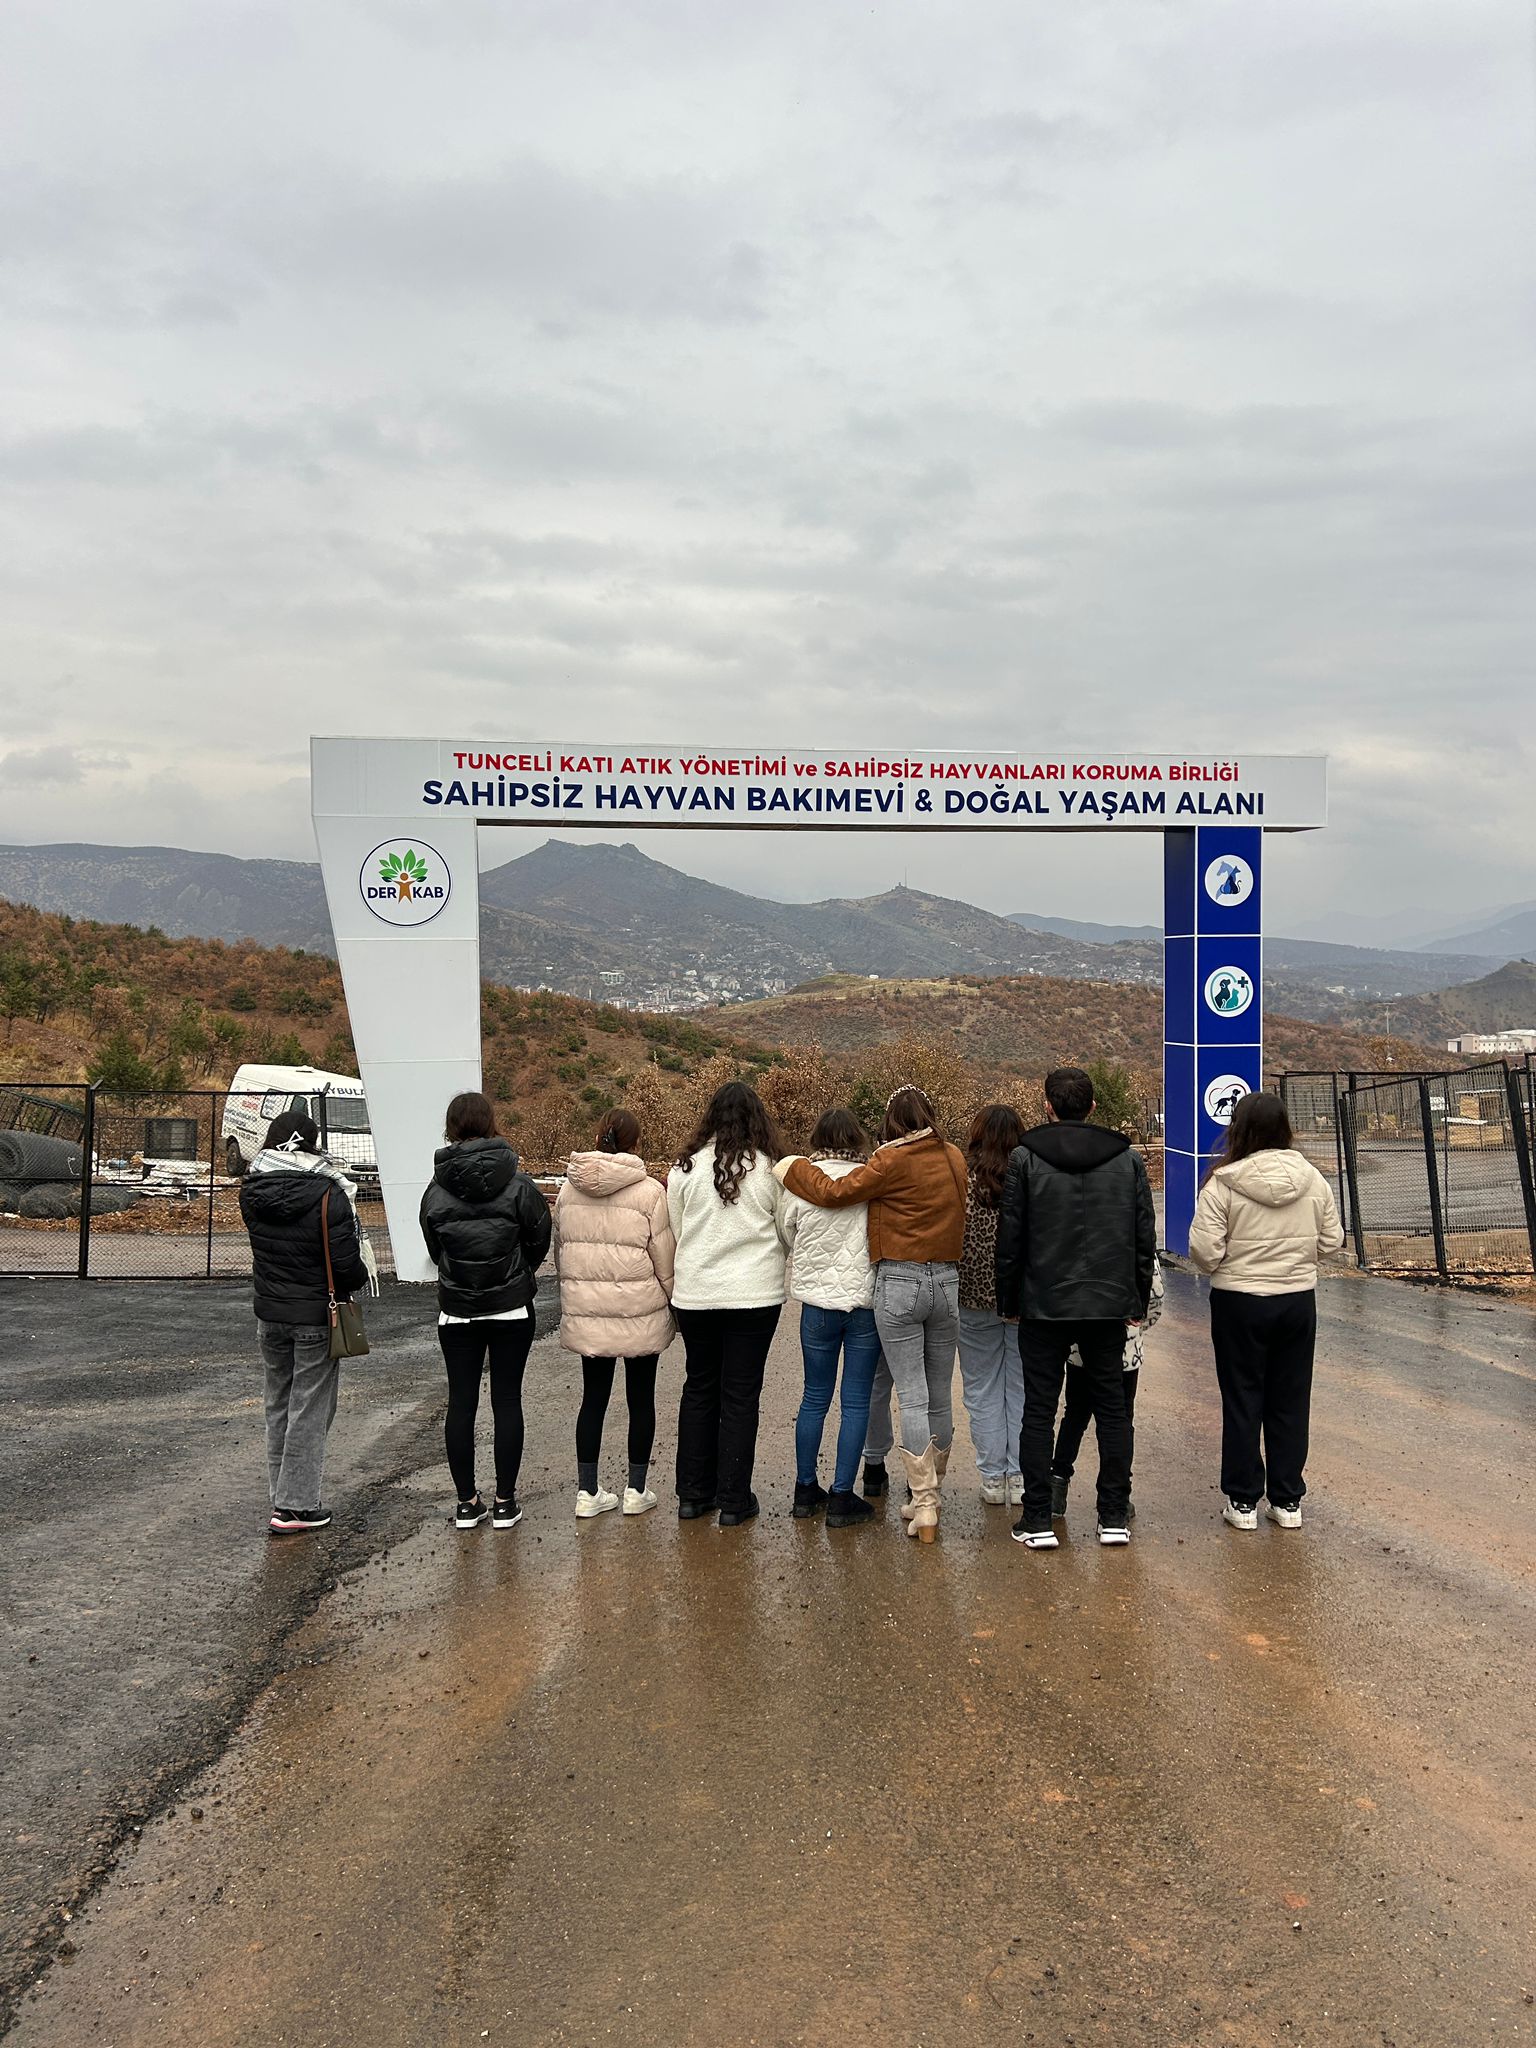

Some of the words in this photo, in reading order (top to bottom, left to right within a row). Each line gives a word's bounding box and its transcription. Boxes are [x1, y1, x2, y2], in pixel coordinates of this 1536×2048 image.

[453, 751, 553, 773] TUNCELİ
[560, 755, 614, 774] KATI
[620, 757, 673, 775] ATIK
[679, 754, 788, 778] YÖNETİMİ
[793, 762, 818, 778] ve
[824, 757, 924, 780] SAHİPSİZ
[929, 762, 1066, 781] HAYVANLARI
[1072, 763, 1163, 782] KORUMA
[1168, 762, 1239, 783] BİRLİĞİ
[422, 774, 584, 809] SAHİPSİZ
[595, 784, 735, 811] HAYVAN
[747, 781, 904, 813] BAKIMEVİ
[914, 788, 933, 813] &
[944, 783, 1050, 814] DOĞAL
[1058, 790, 1166, 822] YAŞAM
[1175, 791, 1264, 815] ALANI
[367, 886, 397, 899] DER
[412, 886, 444, 899] KAB
